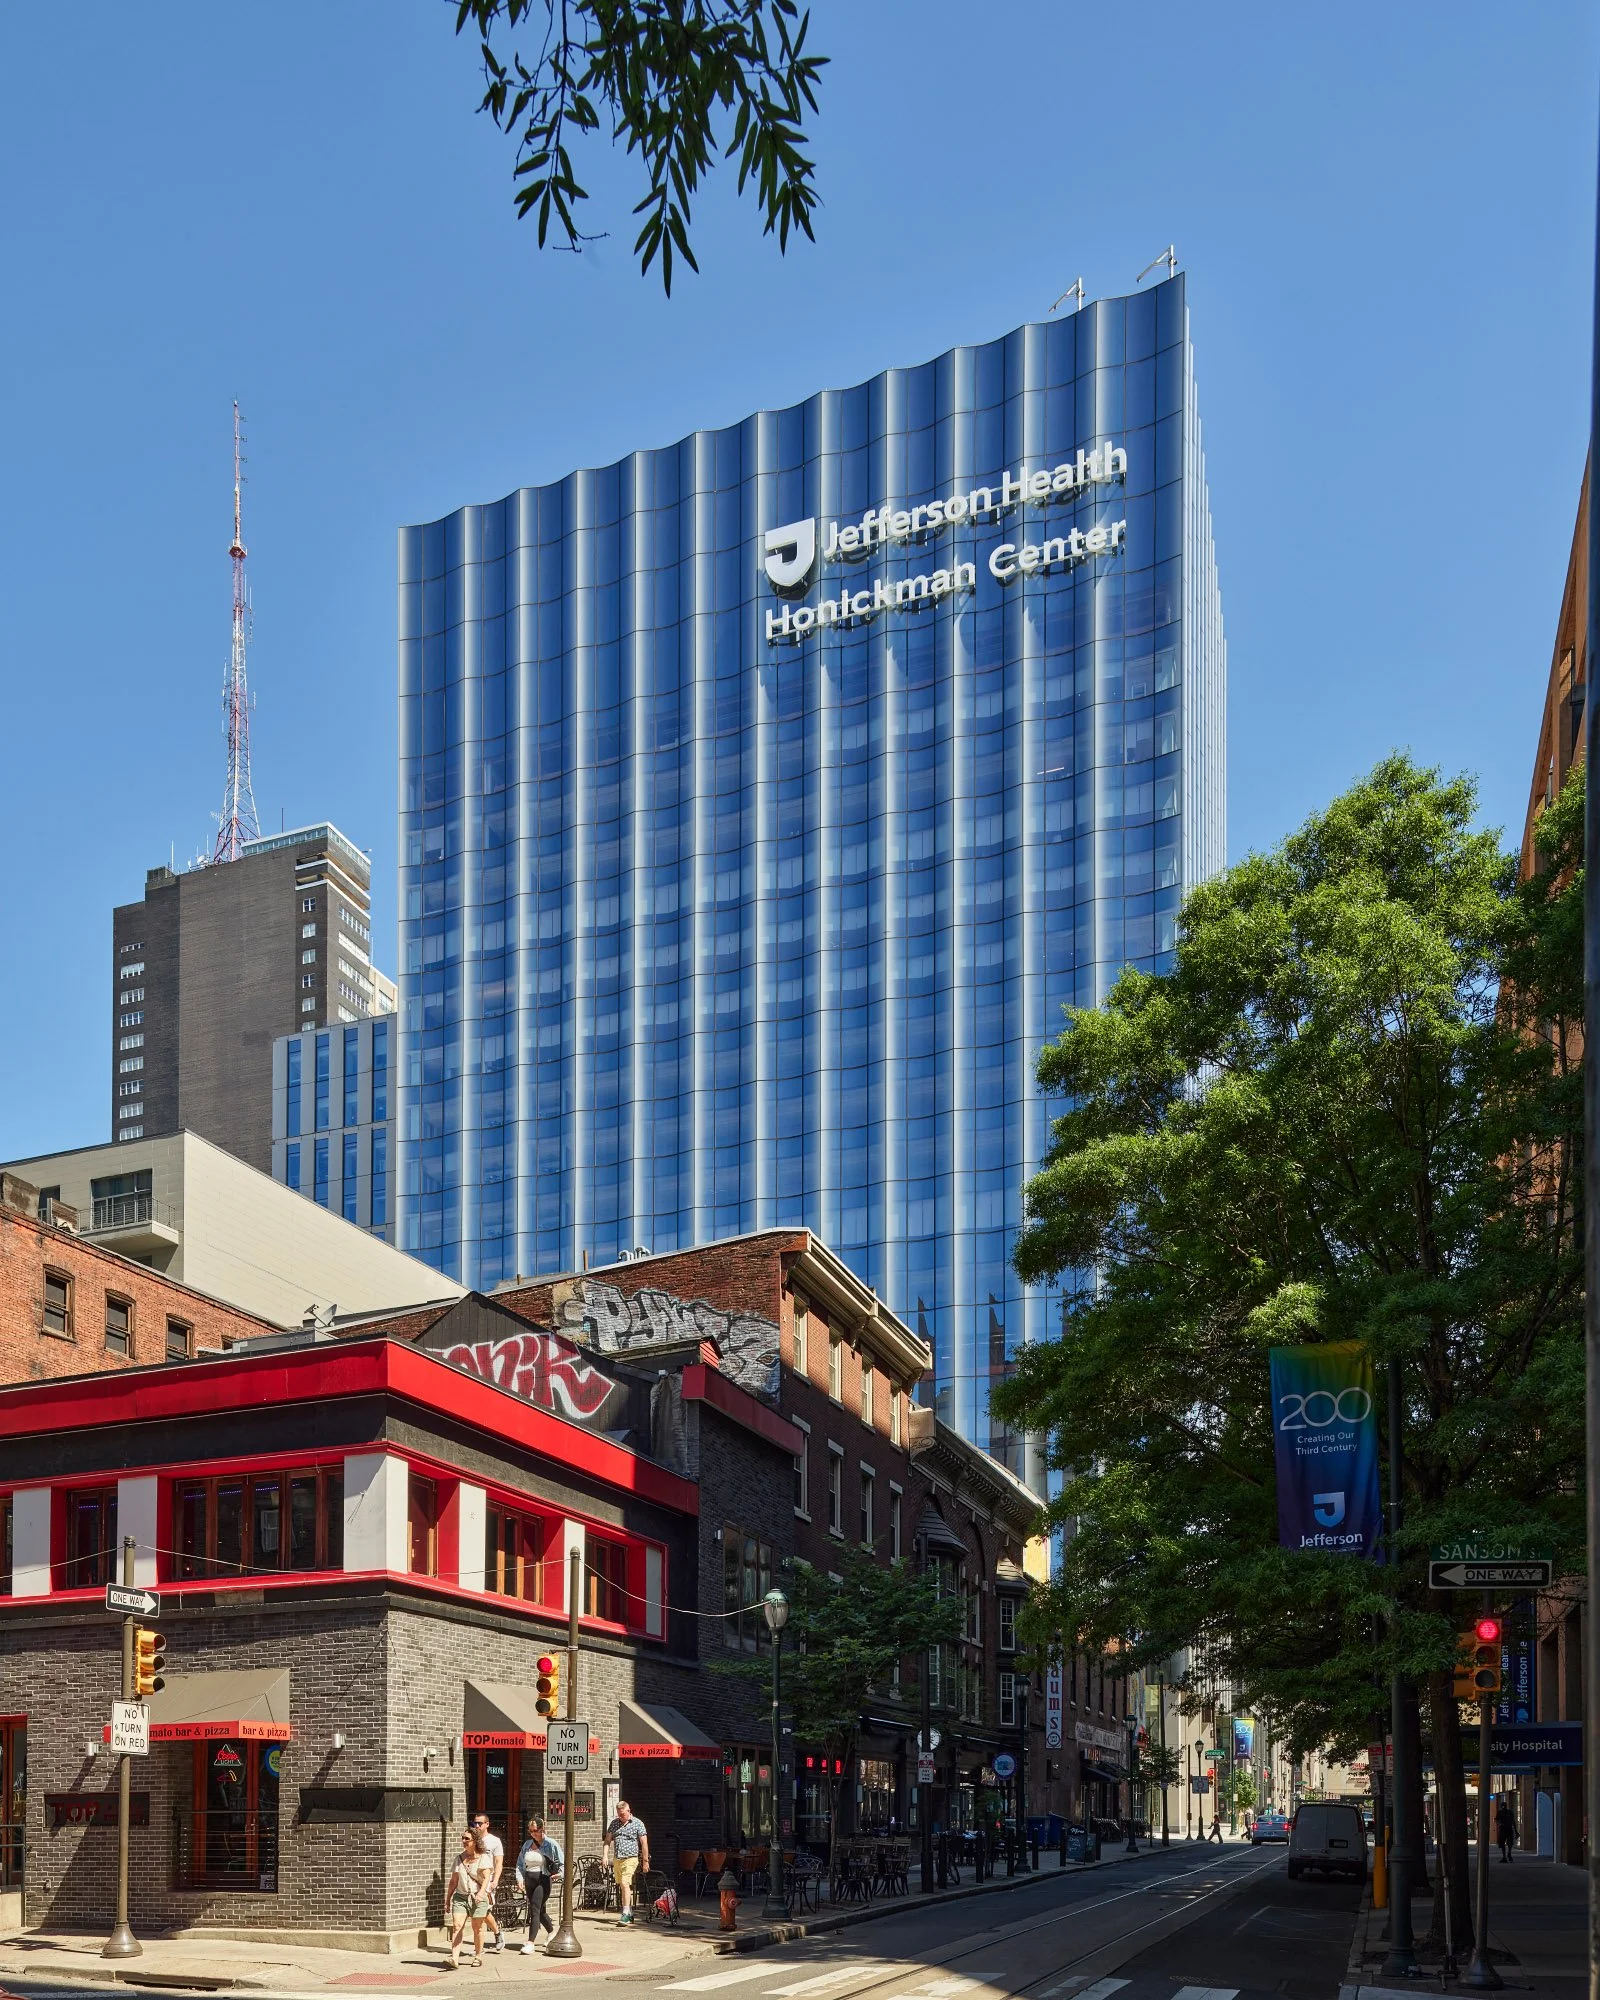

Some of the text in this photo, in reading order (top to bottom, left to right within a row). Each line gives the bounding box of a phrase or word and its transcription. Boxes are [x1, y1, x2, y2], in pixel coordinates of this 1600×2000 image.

[824, 440, 1127, 559] Jefferson Health
[765, 519, 1127, 639] Honickman Center
[1280, 1387, 1371, 1431] 200
[1297, 1432, 1355, 1444] Creating Our
[1296, 1443, 1358, 1456] Third Century
[1300, 1533, 1363, 1548] Jefferson
[1439, 1544, 1520, 1560] SANSOM
[1465, 1570, 1537, 1580] ONE WAY
[112, 1593, 144, 1606] ONE WAY
[124, 1708, 138, 1719] NO
[120, 1722, 141, 1734] TURN
[150, 1727, 230, 1738] mato bar & pizza
[243, 1725, 288, 1738] bar & pizza
[560, 1729, 575, 1739] NO
[115, 1737, 145, 1748] ON RED
[466, 1734, 524, 1745] TOP tomato
[531, 1735, 547, 1747] TOP
[556, 1742, 579, 1752] TURN
[622, 1747, 670, 1756] bar & pizza
[1491, 1740, 1563, 1753] sity Hospital
[217, 1750, 239, 1761] Coors
[550, 1756, 584, 1765] ON RED
